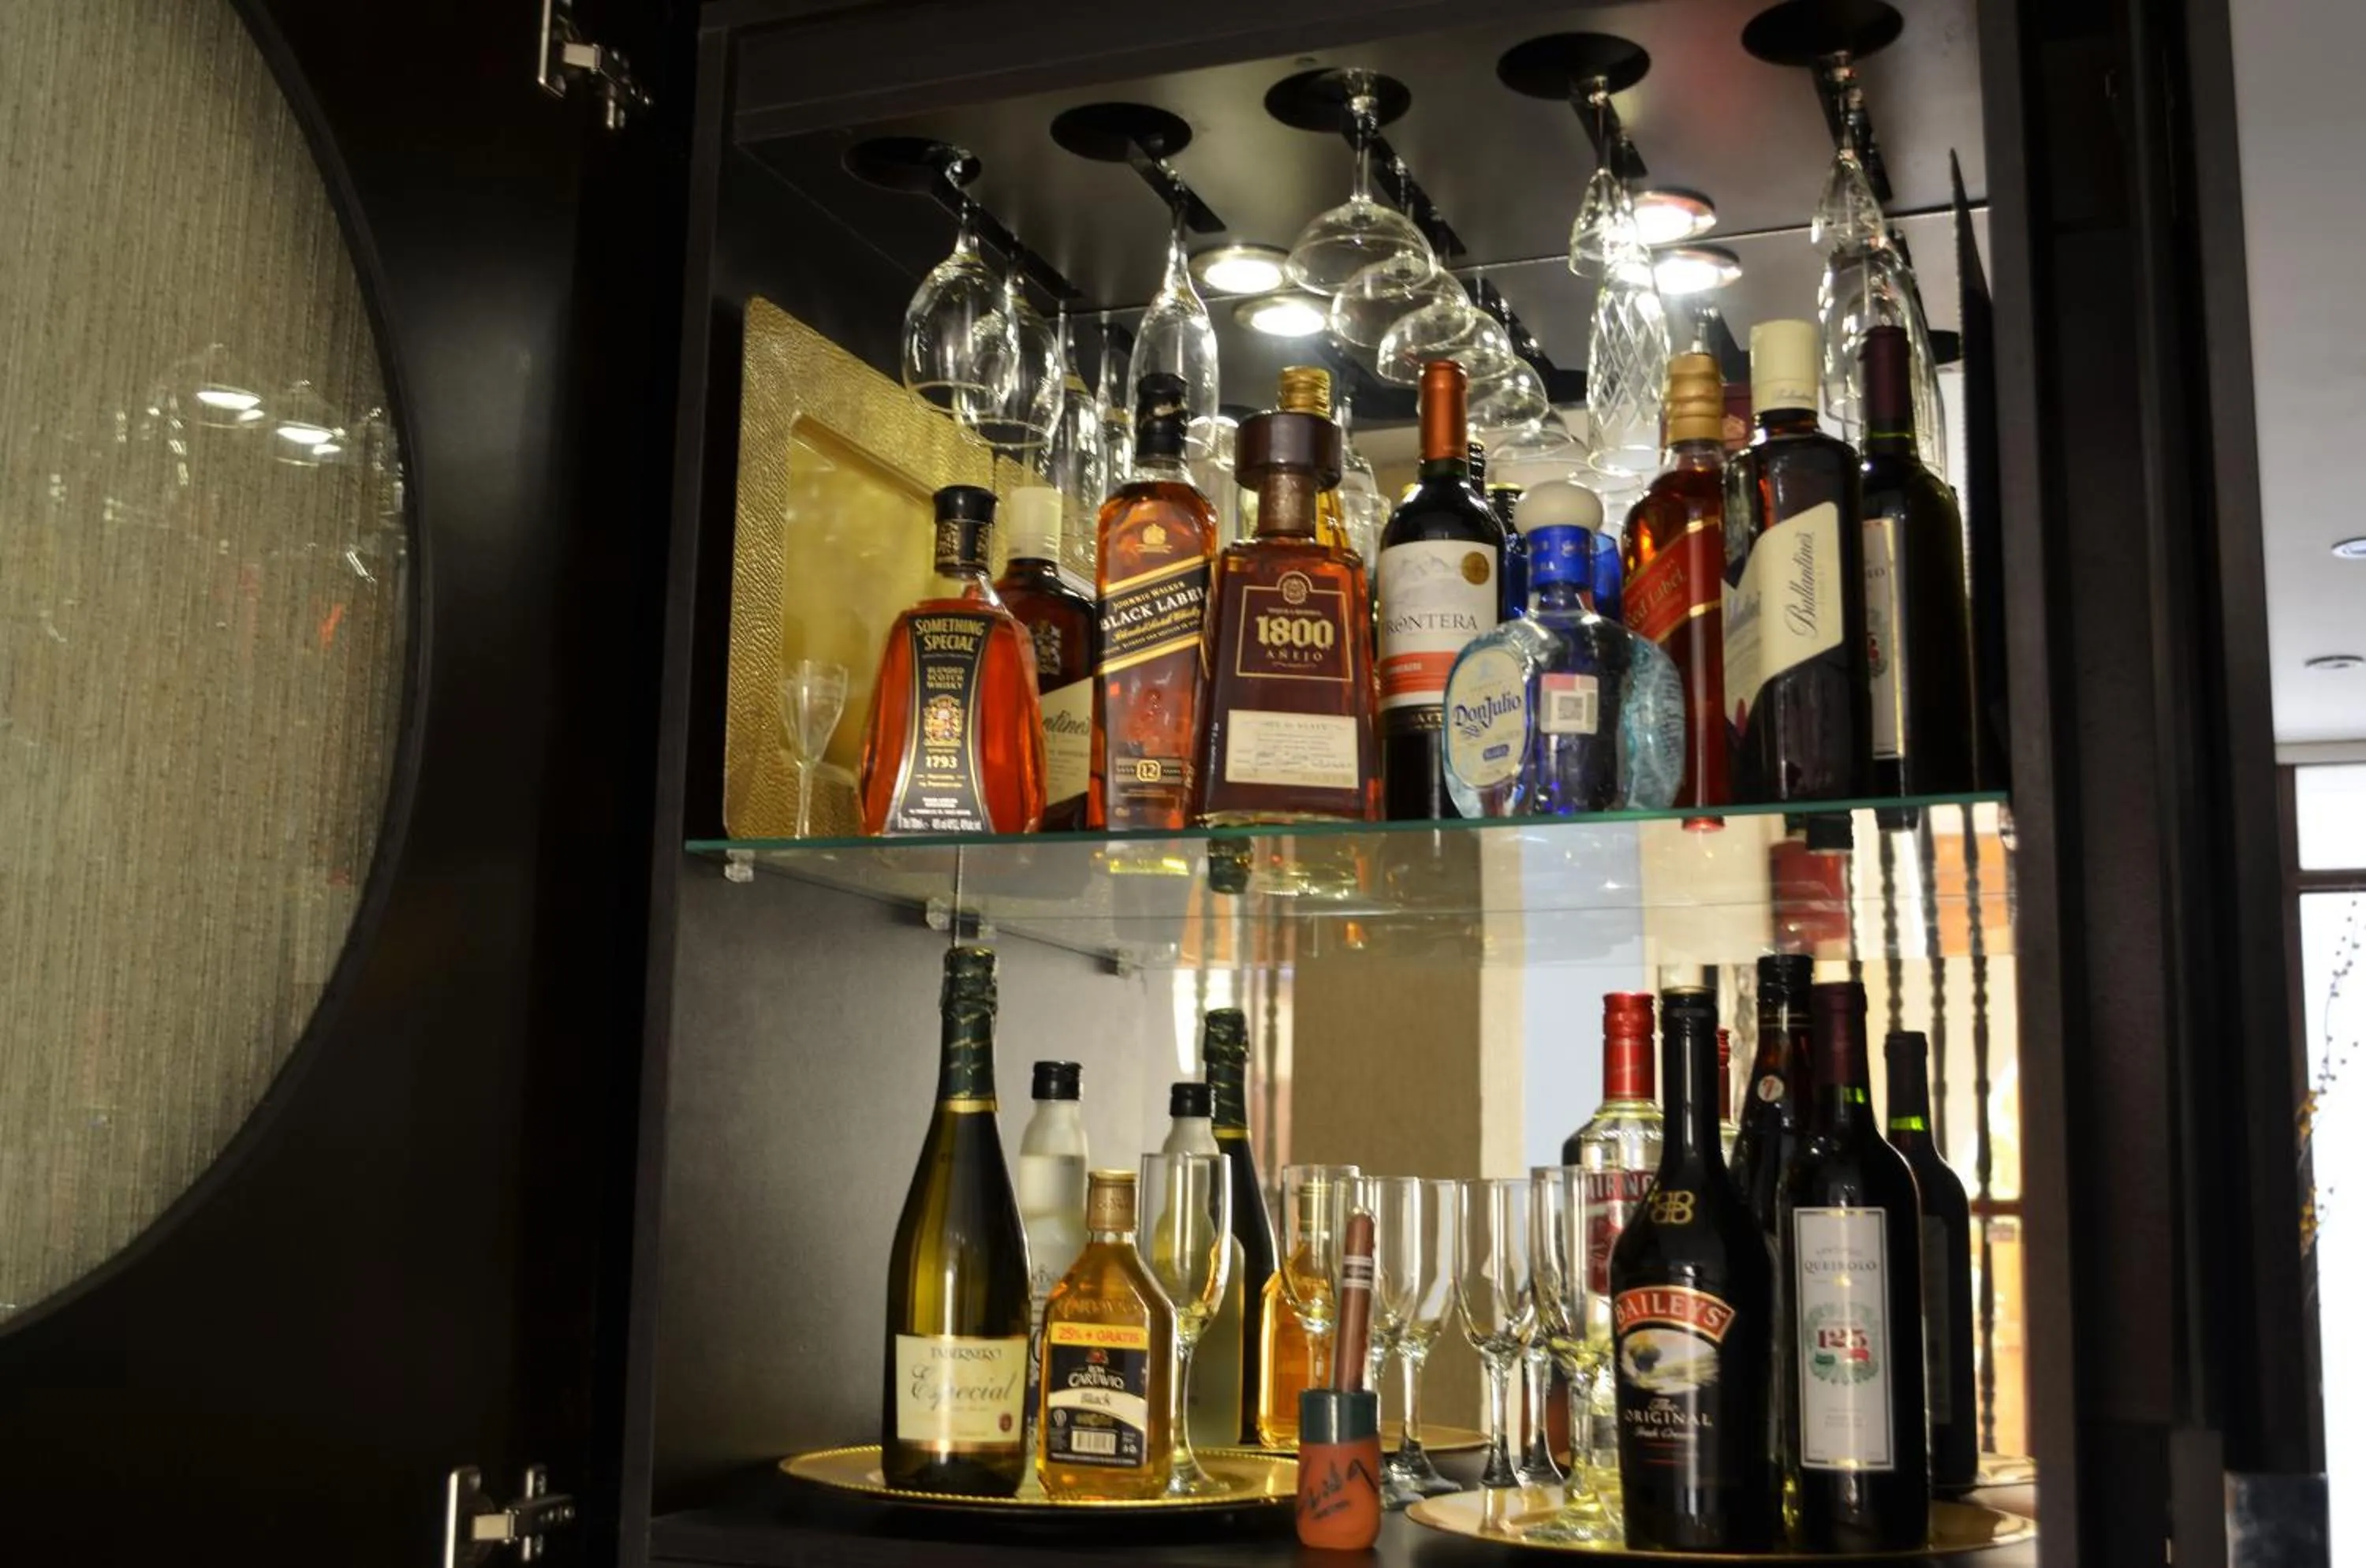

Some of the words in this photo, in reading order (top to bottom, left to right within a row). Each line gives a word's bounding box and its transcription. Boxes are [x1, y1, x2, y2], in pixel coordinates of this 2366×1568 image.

[1099, 603, 1153, 632] BLACK
[1155, 586, 1204, 614] LABEL
[915, 618, 985, 636] SOMETHING
[1256, 615, 1334, 651] 1800
[924, 634, 974, 652] SPECIAL
[926, 755, 957, 769] 1793
